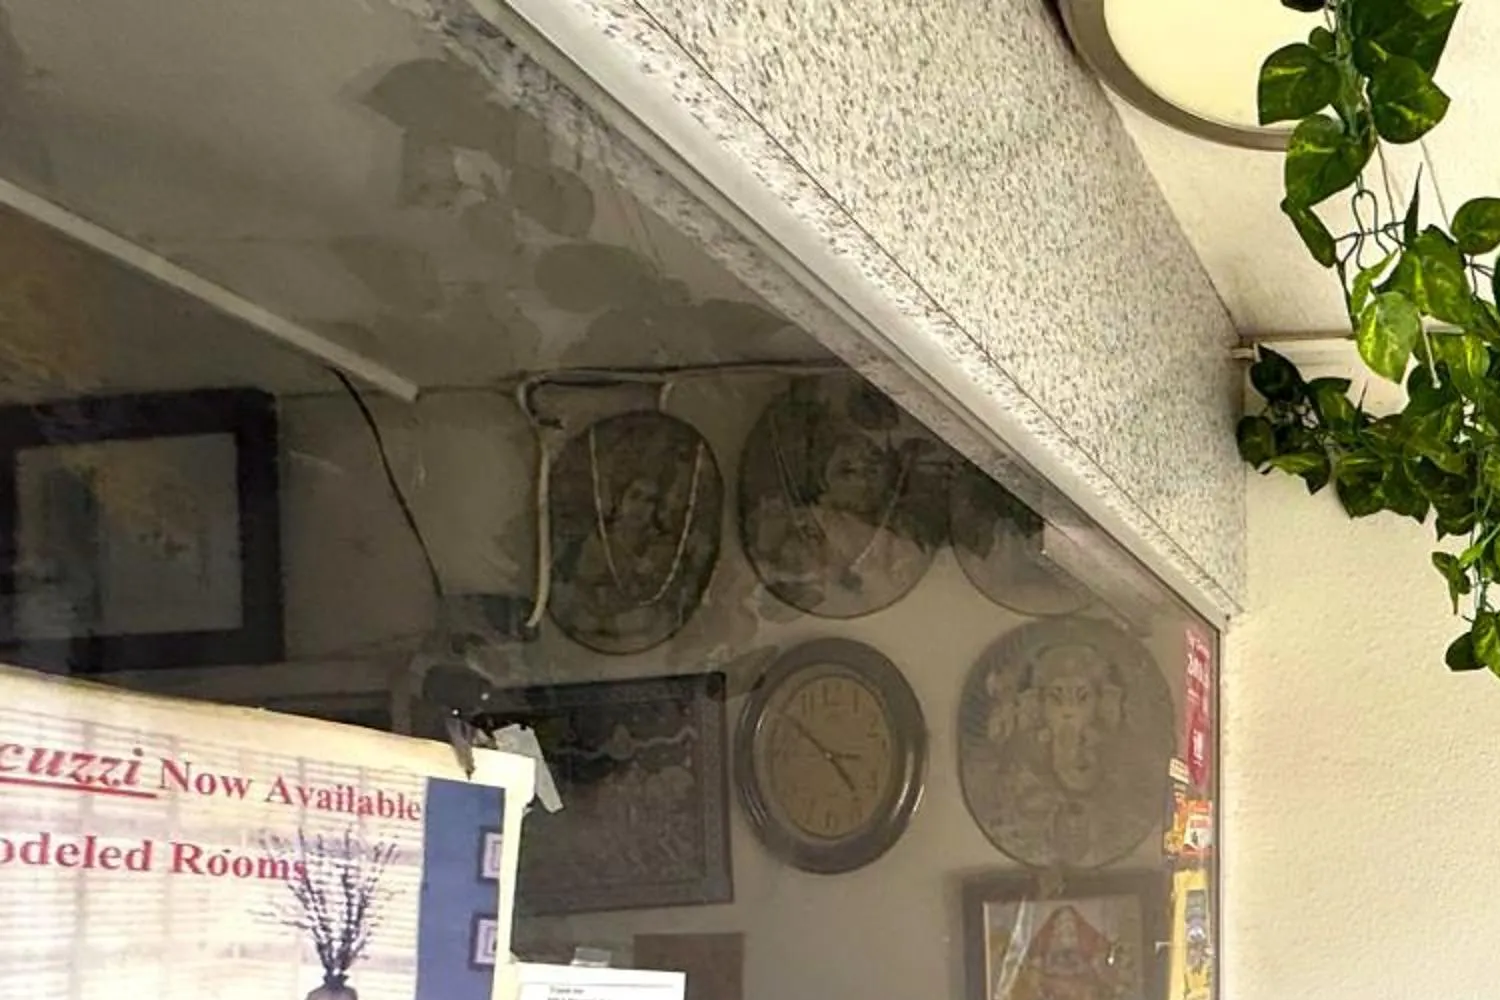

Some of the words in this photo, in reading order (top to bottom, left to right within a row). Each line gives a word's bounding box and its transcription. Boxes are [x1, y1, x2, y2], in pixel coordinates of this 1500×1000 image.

[159, 757, 253, 799] Now
[265, 776, 421, 822] Available
[169, 841, 308, 882] Rooms
